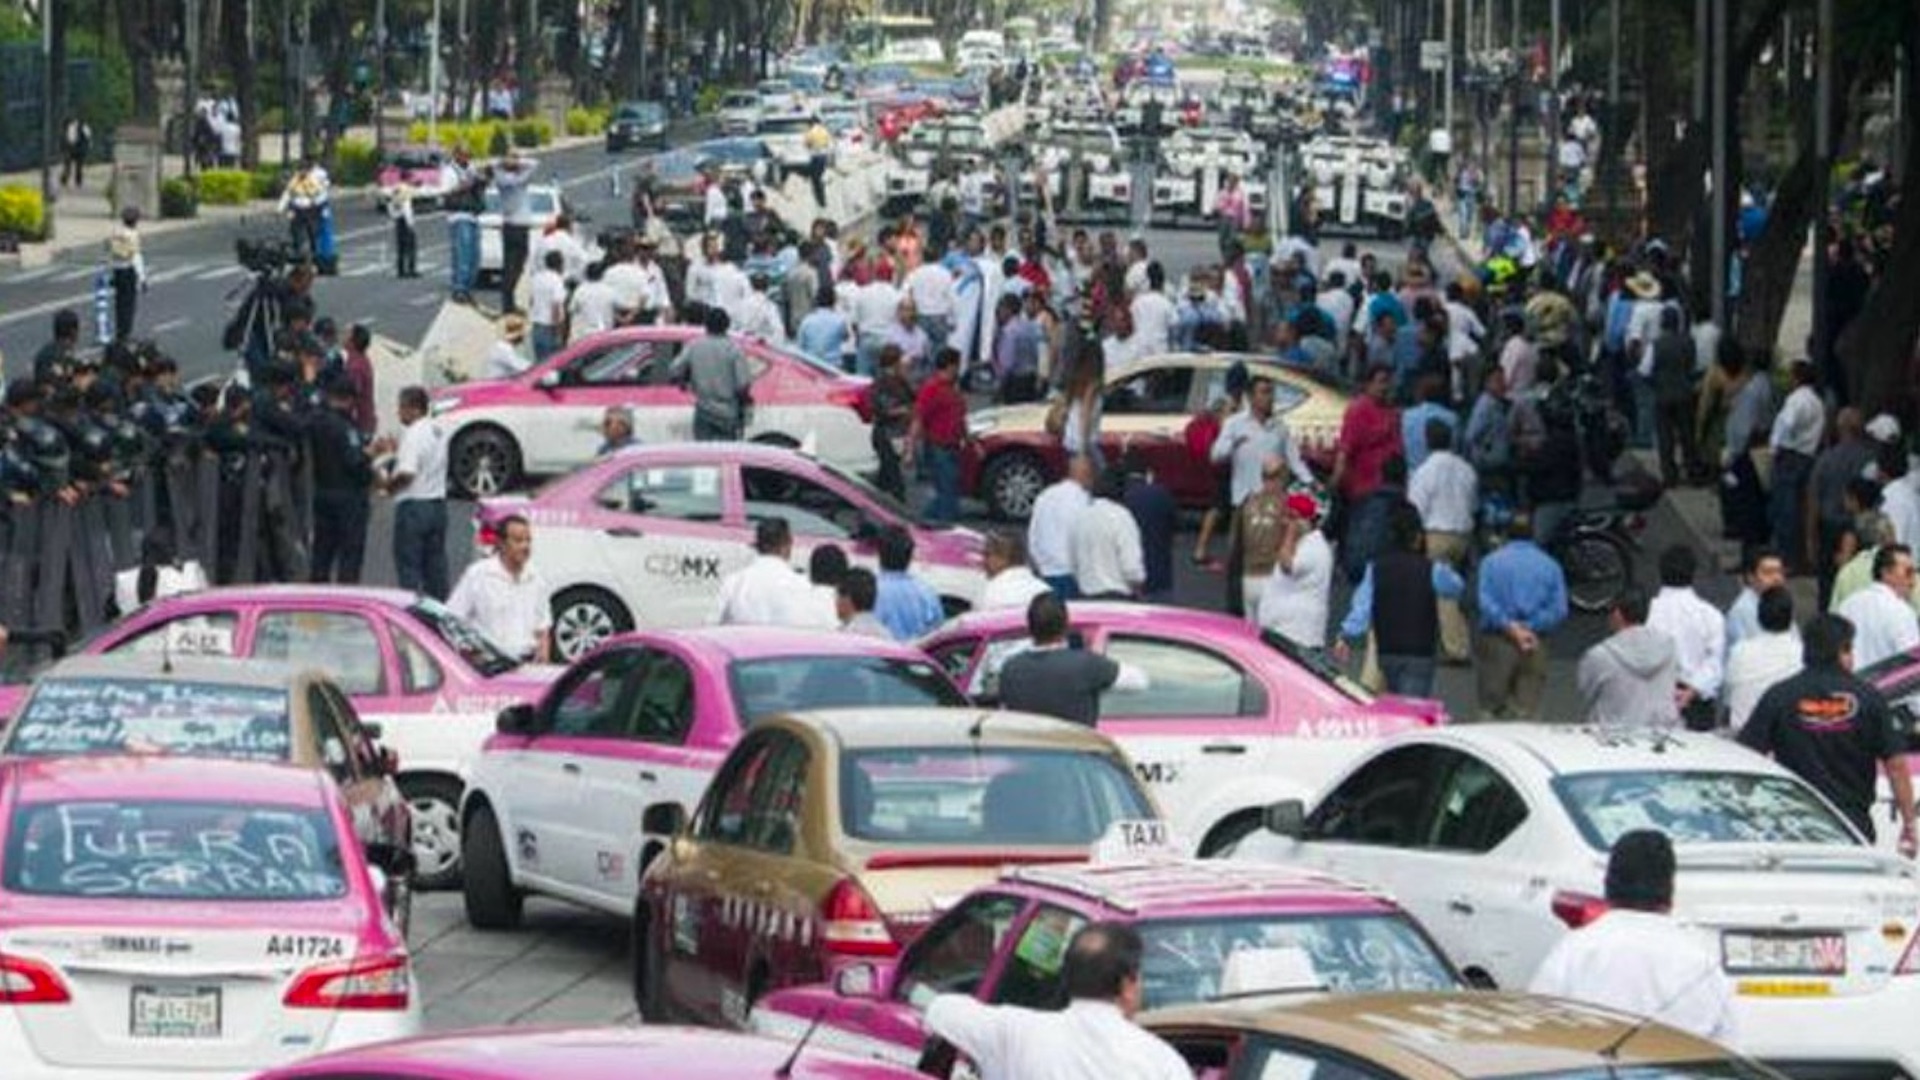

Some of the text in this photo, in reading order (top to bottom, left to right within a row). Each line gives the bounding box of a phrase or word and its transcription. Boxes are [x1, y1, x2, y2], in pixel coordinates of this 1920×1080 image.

[644, 554, 720, 578] CDMX
[57, 803, 312, 866] FUERA
[1119, 823, 1169, 848] TAXI
[266, 934, 343, 957] A41724
